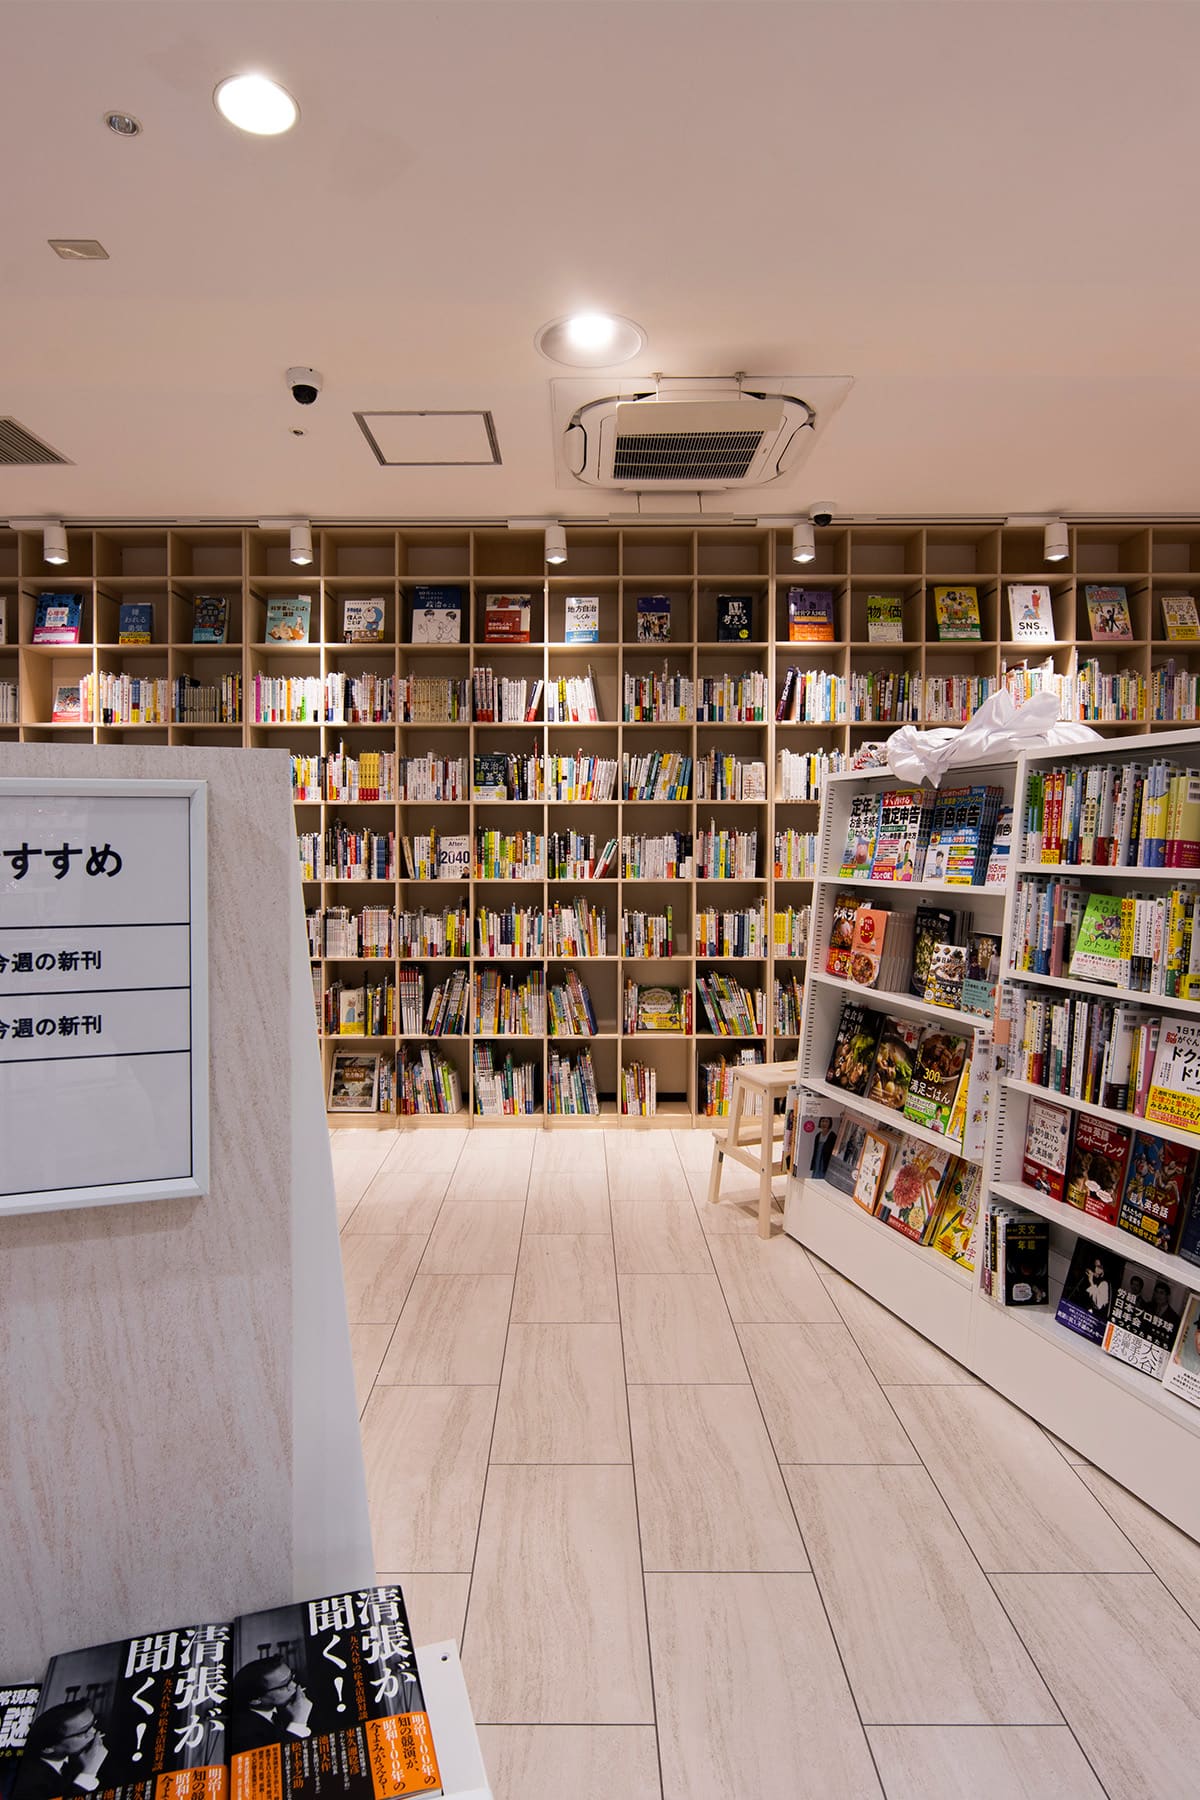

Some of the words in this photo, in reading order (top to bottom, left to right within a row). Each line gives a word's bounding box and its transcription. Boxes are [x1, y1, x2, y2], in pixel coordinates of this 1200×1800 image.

[1018, 621, 1040, 630] SNS
[881, 805, 920, 825] 確定申告
[934, 804, 980, 830] 青色申告
[0, 842, 123, 880] すすめ
[441, 850, 470, 864] 2040
[1093, 905, 1120, 915] ADH
[1084, 940, 1120, 953] のトリセ
[1172, 1046, 1200, 1065] ドク
[923, 1067, 940, 1084] 300
[908, 1078, 951, 1105] 満足ごはん
[1076, 1131, 1125, 1157] シャドーイング
[1018, 1224, 1036, 1235] 天文
[1117, 1288, 1138, 1305] 労組
[1111, 1308, 1142, 1328] 選手会
[1114, 1298, 1174, 1333] 日本プロ野球
[1140, 1343, 1160, 1374] 大谷
[308, 1594, 356, 1713] 聞く！
[355, 1588, 417, 1704] 清張が
[124, 1632, 179, 1763] 聞く！
[174, 1625, 231, 1754] 清張が
[0, 1706, 36, 1749] 謎
[383, 1718, 406, 1791] 昭和100年の
